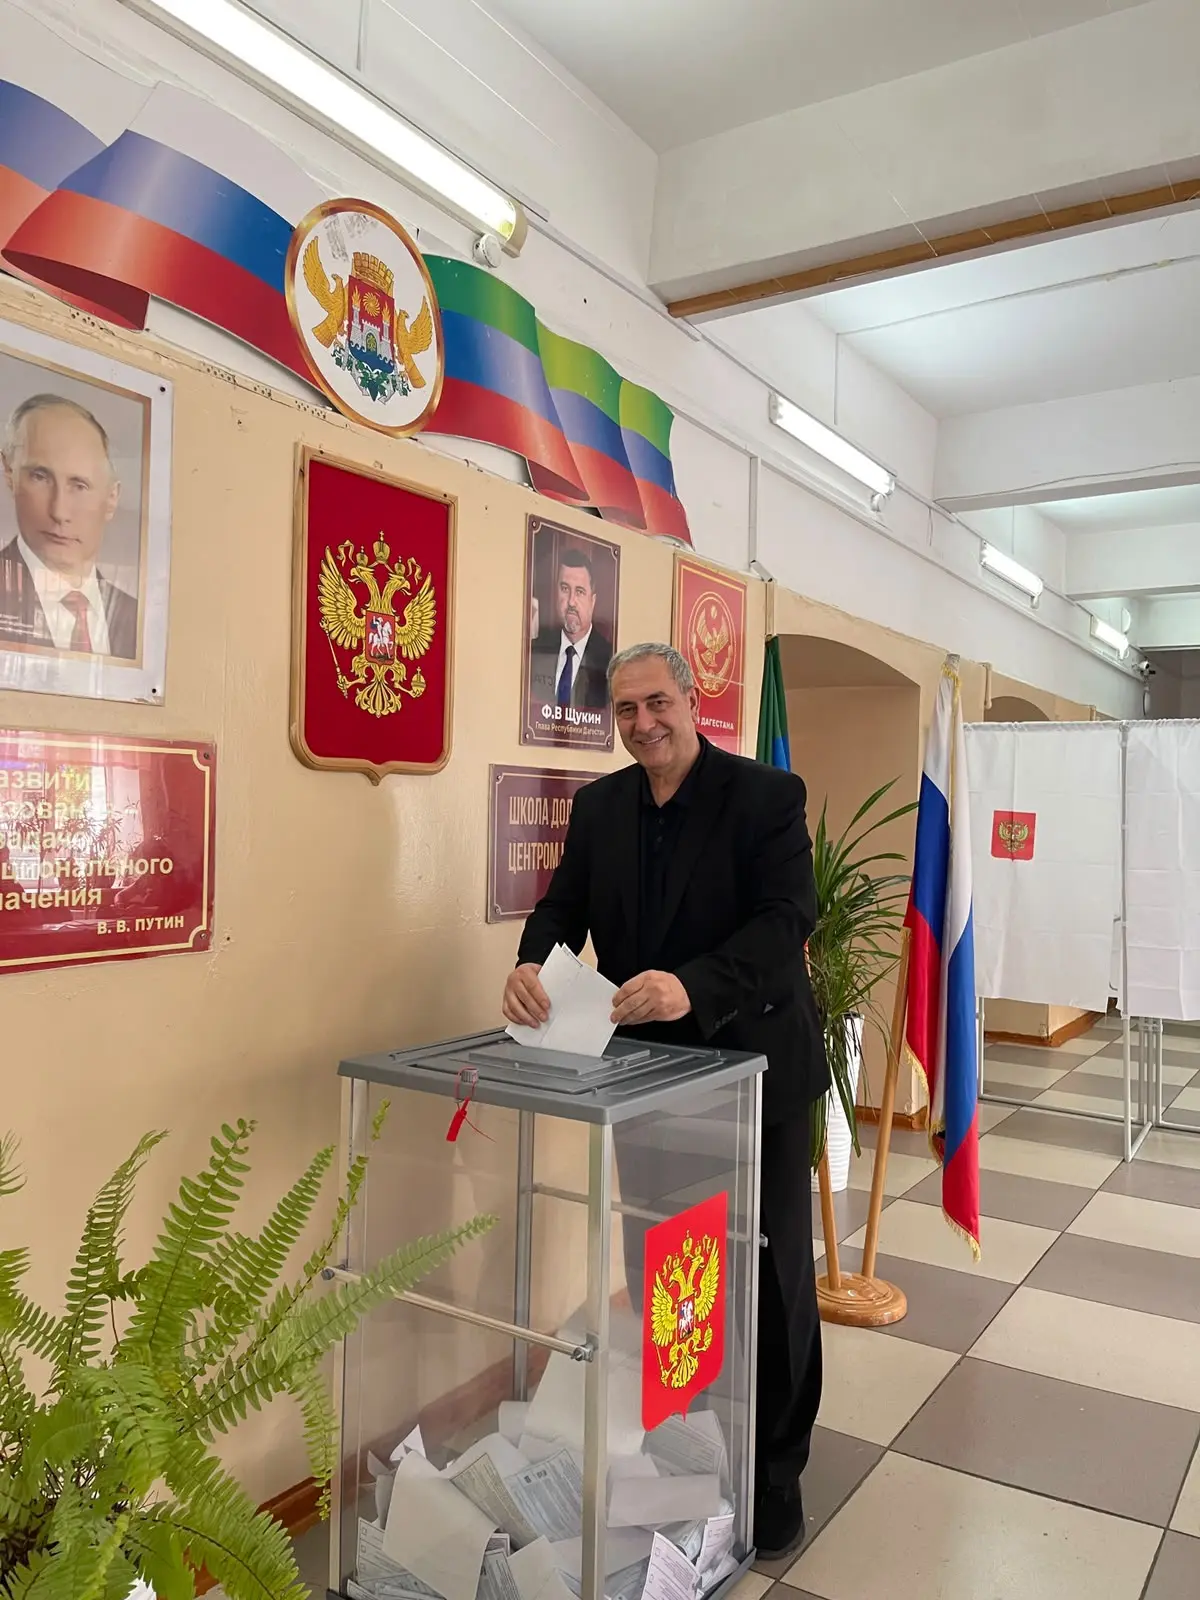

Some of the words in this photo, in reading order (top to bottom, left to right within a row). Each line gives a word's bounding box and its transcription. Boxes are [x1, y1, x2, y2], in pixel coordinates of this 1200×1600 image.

[541, 704, 562, 719] Ф.В
[565, 707, 602, 725] Щукин
[700, 716, 735, 730] ДАГЕСТАНА
[535, 721, 550, 732] Глава
[509, 796, 549, 826] ШКОЛА
[508, 842, 559, 875] ЦЕНТРОМ
[0, 888, 102, 911] ачения
[97, 921, 112, 935] В.
[116, 918, 131, 933] В.
[135, 915, 184, 931] ПУТИН
